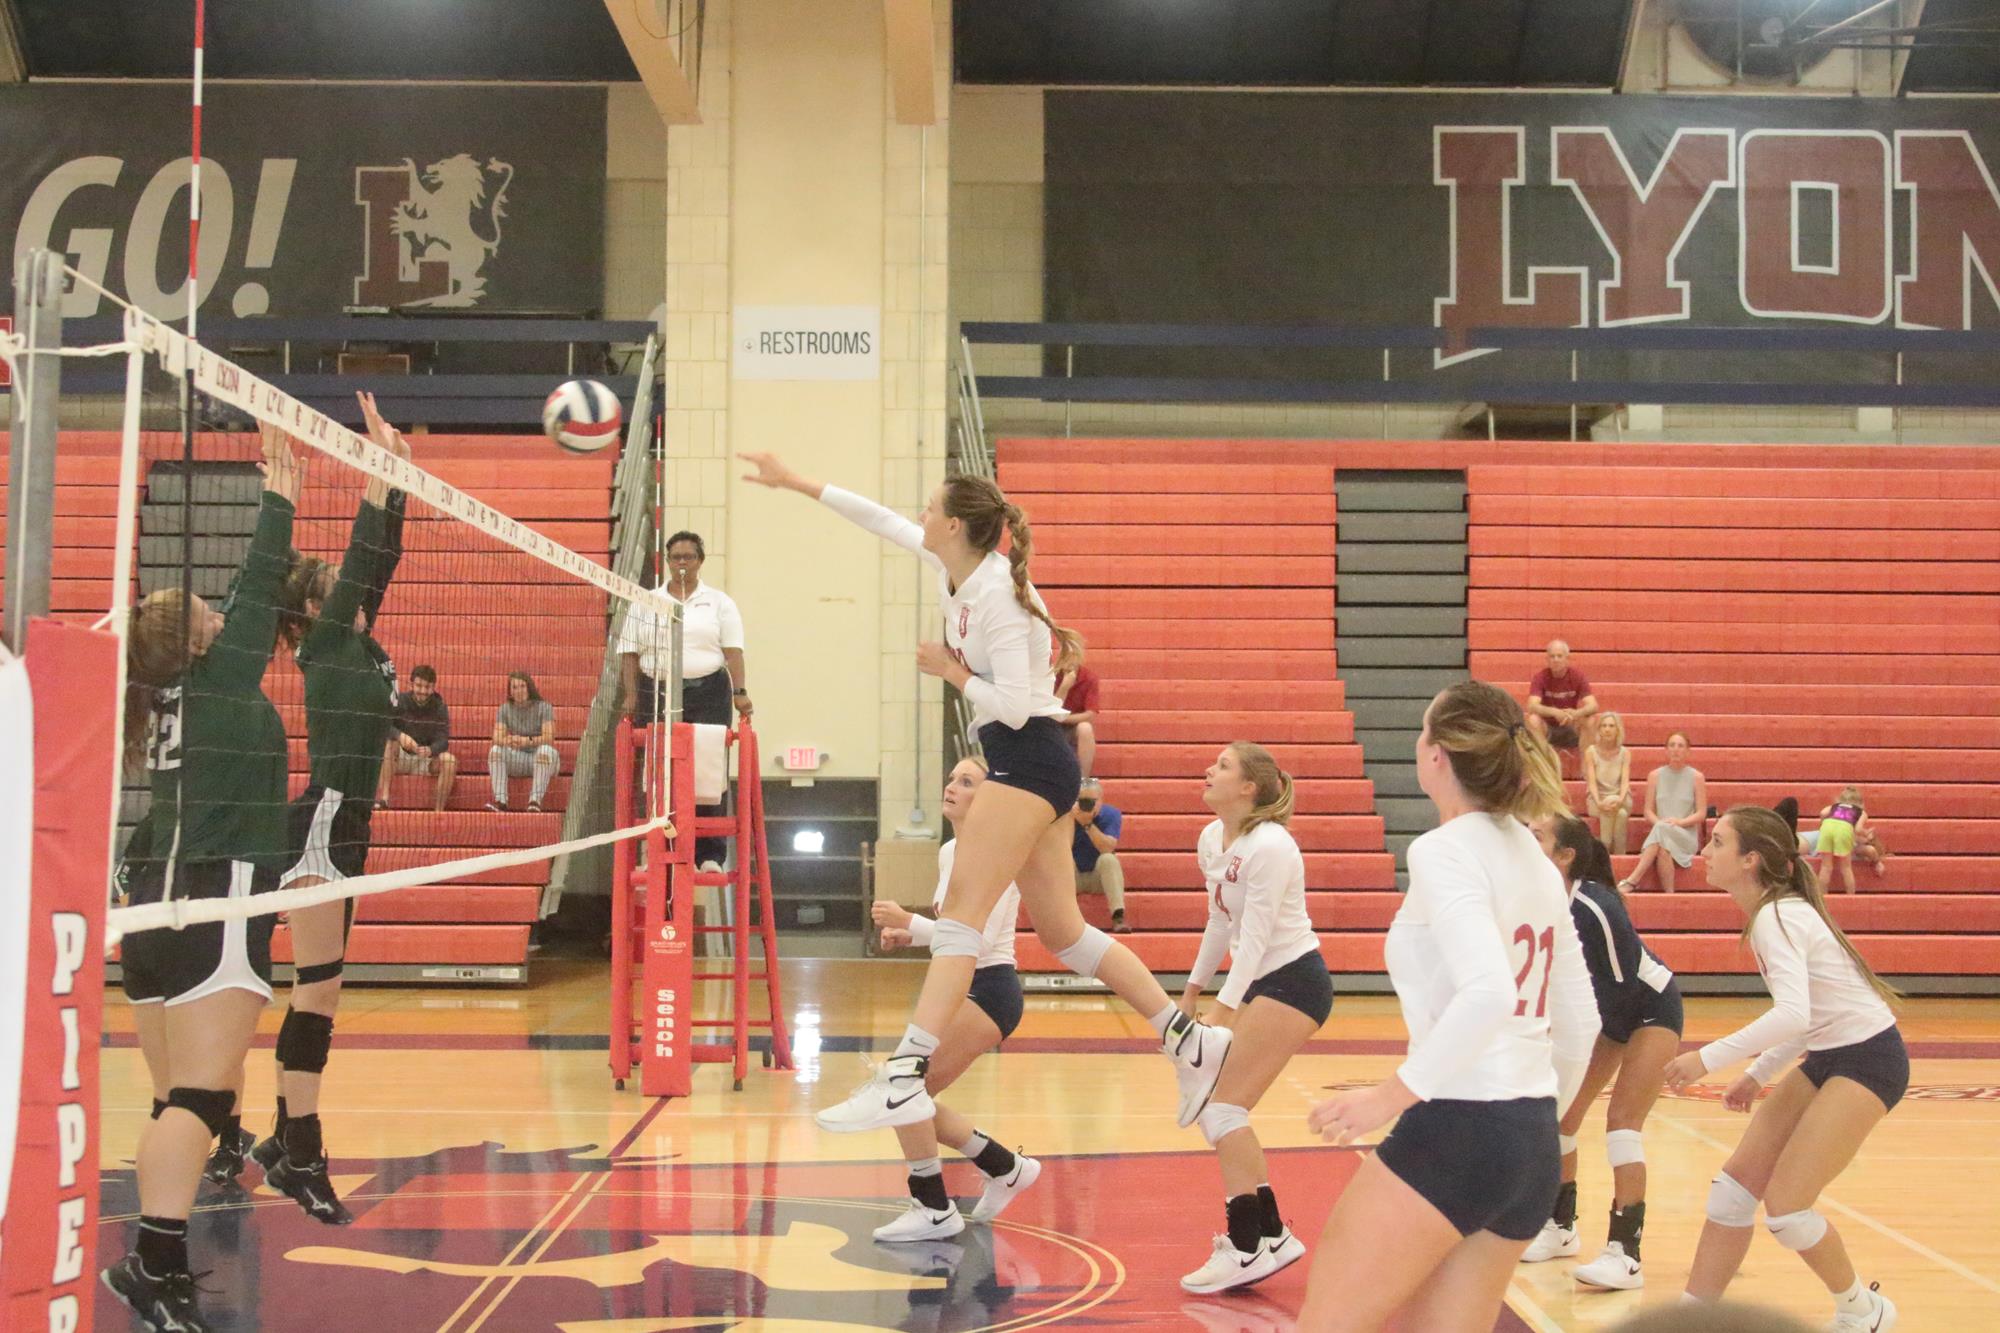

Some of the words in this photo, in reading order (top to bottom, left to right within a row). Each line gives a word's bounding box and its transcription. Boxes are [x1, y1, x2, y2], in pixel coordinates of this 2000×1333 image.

[14, 155, 297, 320] GO!
[760, 331, 871, 354] RESTROOMS
[790, 748, 816, 768] EXIT
[1513, 923, 1554, 1017] 21
